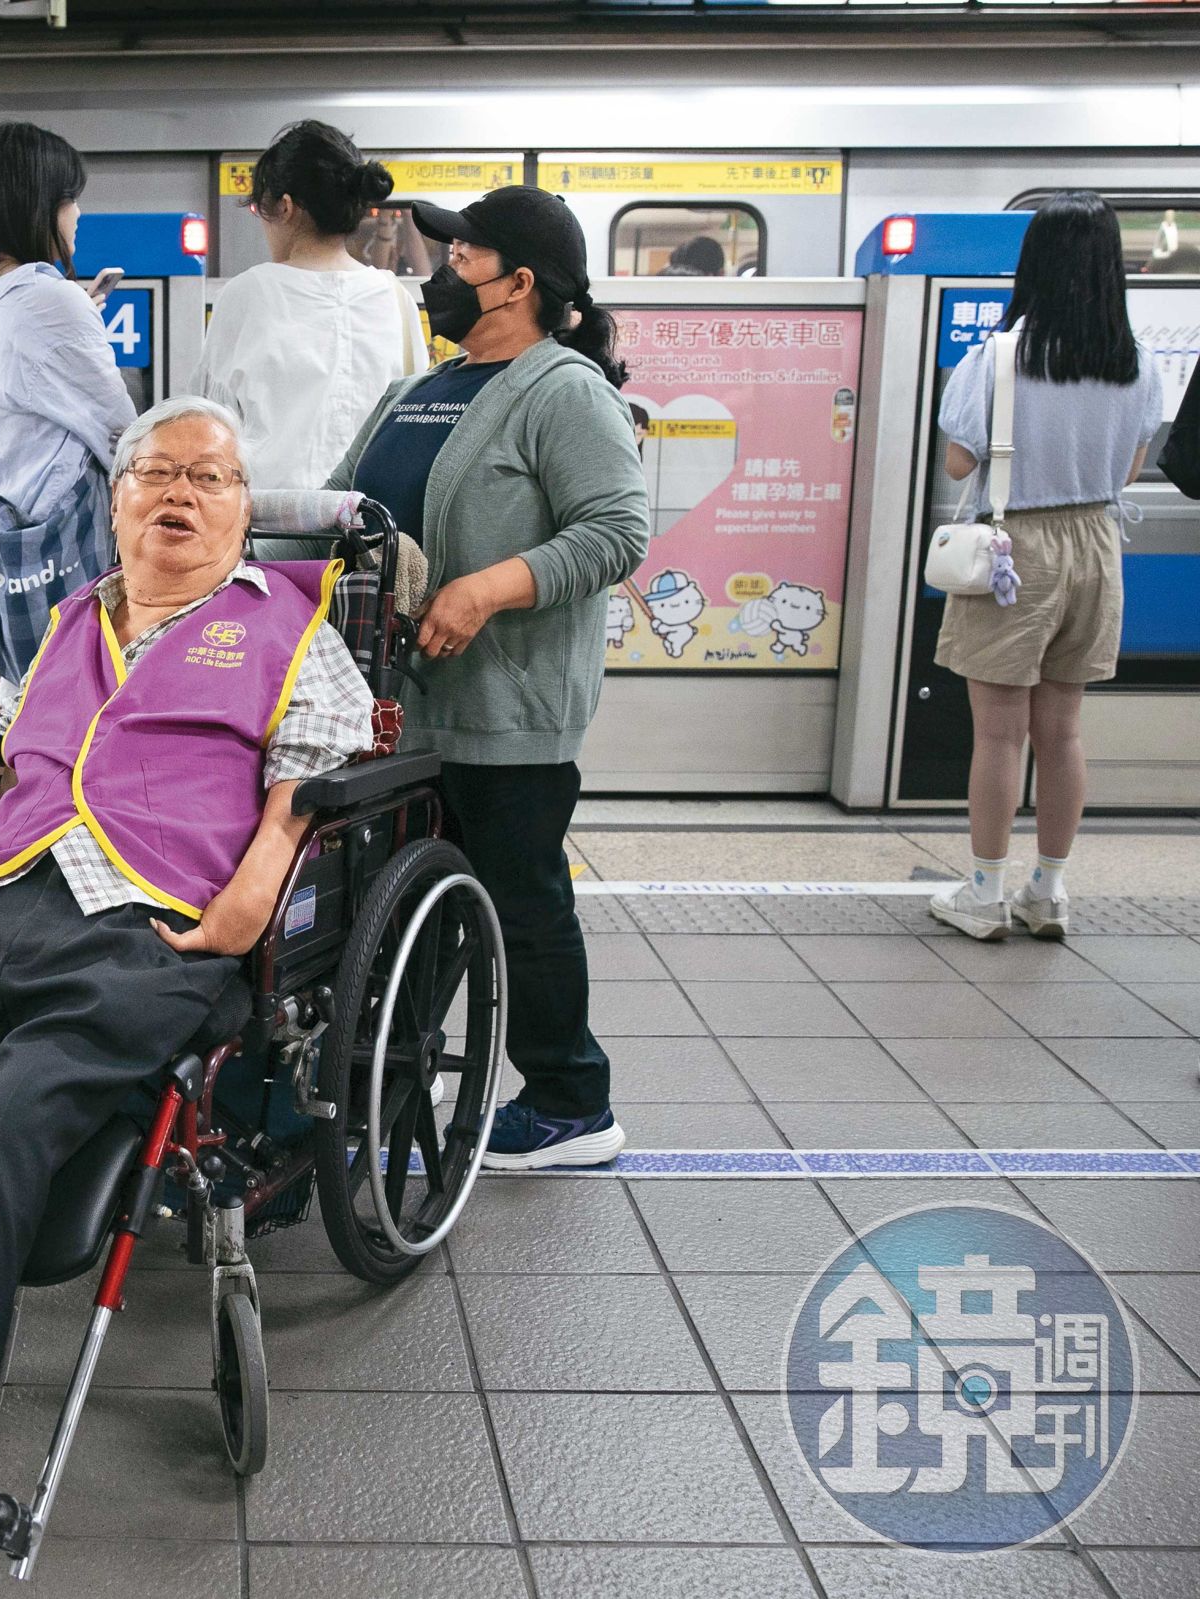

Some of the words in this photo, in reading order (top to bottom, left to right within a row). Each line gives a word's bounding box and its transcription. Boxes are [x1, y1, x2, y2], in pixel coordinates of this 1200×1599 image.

[105, 303, 141, 354] 4
[692, 356, 721, 366] area
[652, 371, 717, 384] expectant
[719, 371, 774, 382] mothers
[789, 370, 842, 383] families
[393, 403, 426, 412] DESERVE
[394, 414, 460, 424] REMEMBRANCE
[715, 508, 751, 519] Please
[752, 510, 776, 521] give
[779, 510, 802, 521] way
[804, 509, 817, 519] to
[714, 524, 769, 535] expectant
[770, 524, 816, 534] mothers
[184, 655, 202, 664] ROC
[638, 884, 769, 894] Waiting
[782, 884, 855, 893] Line
